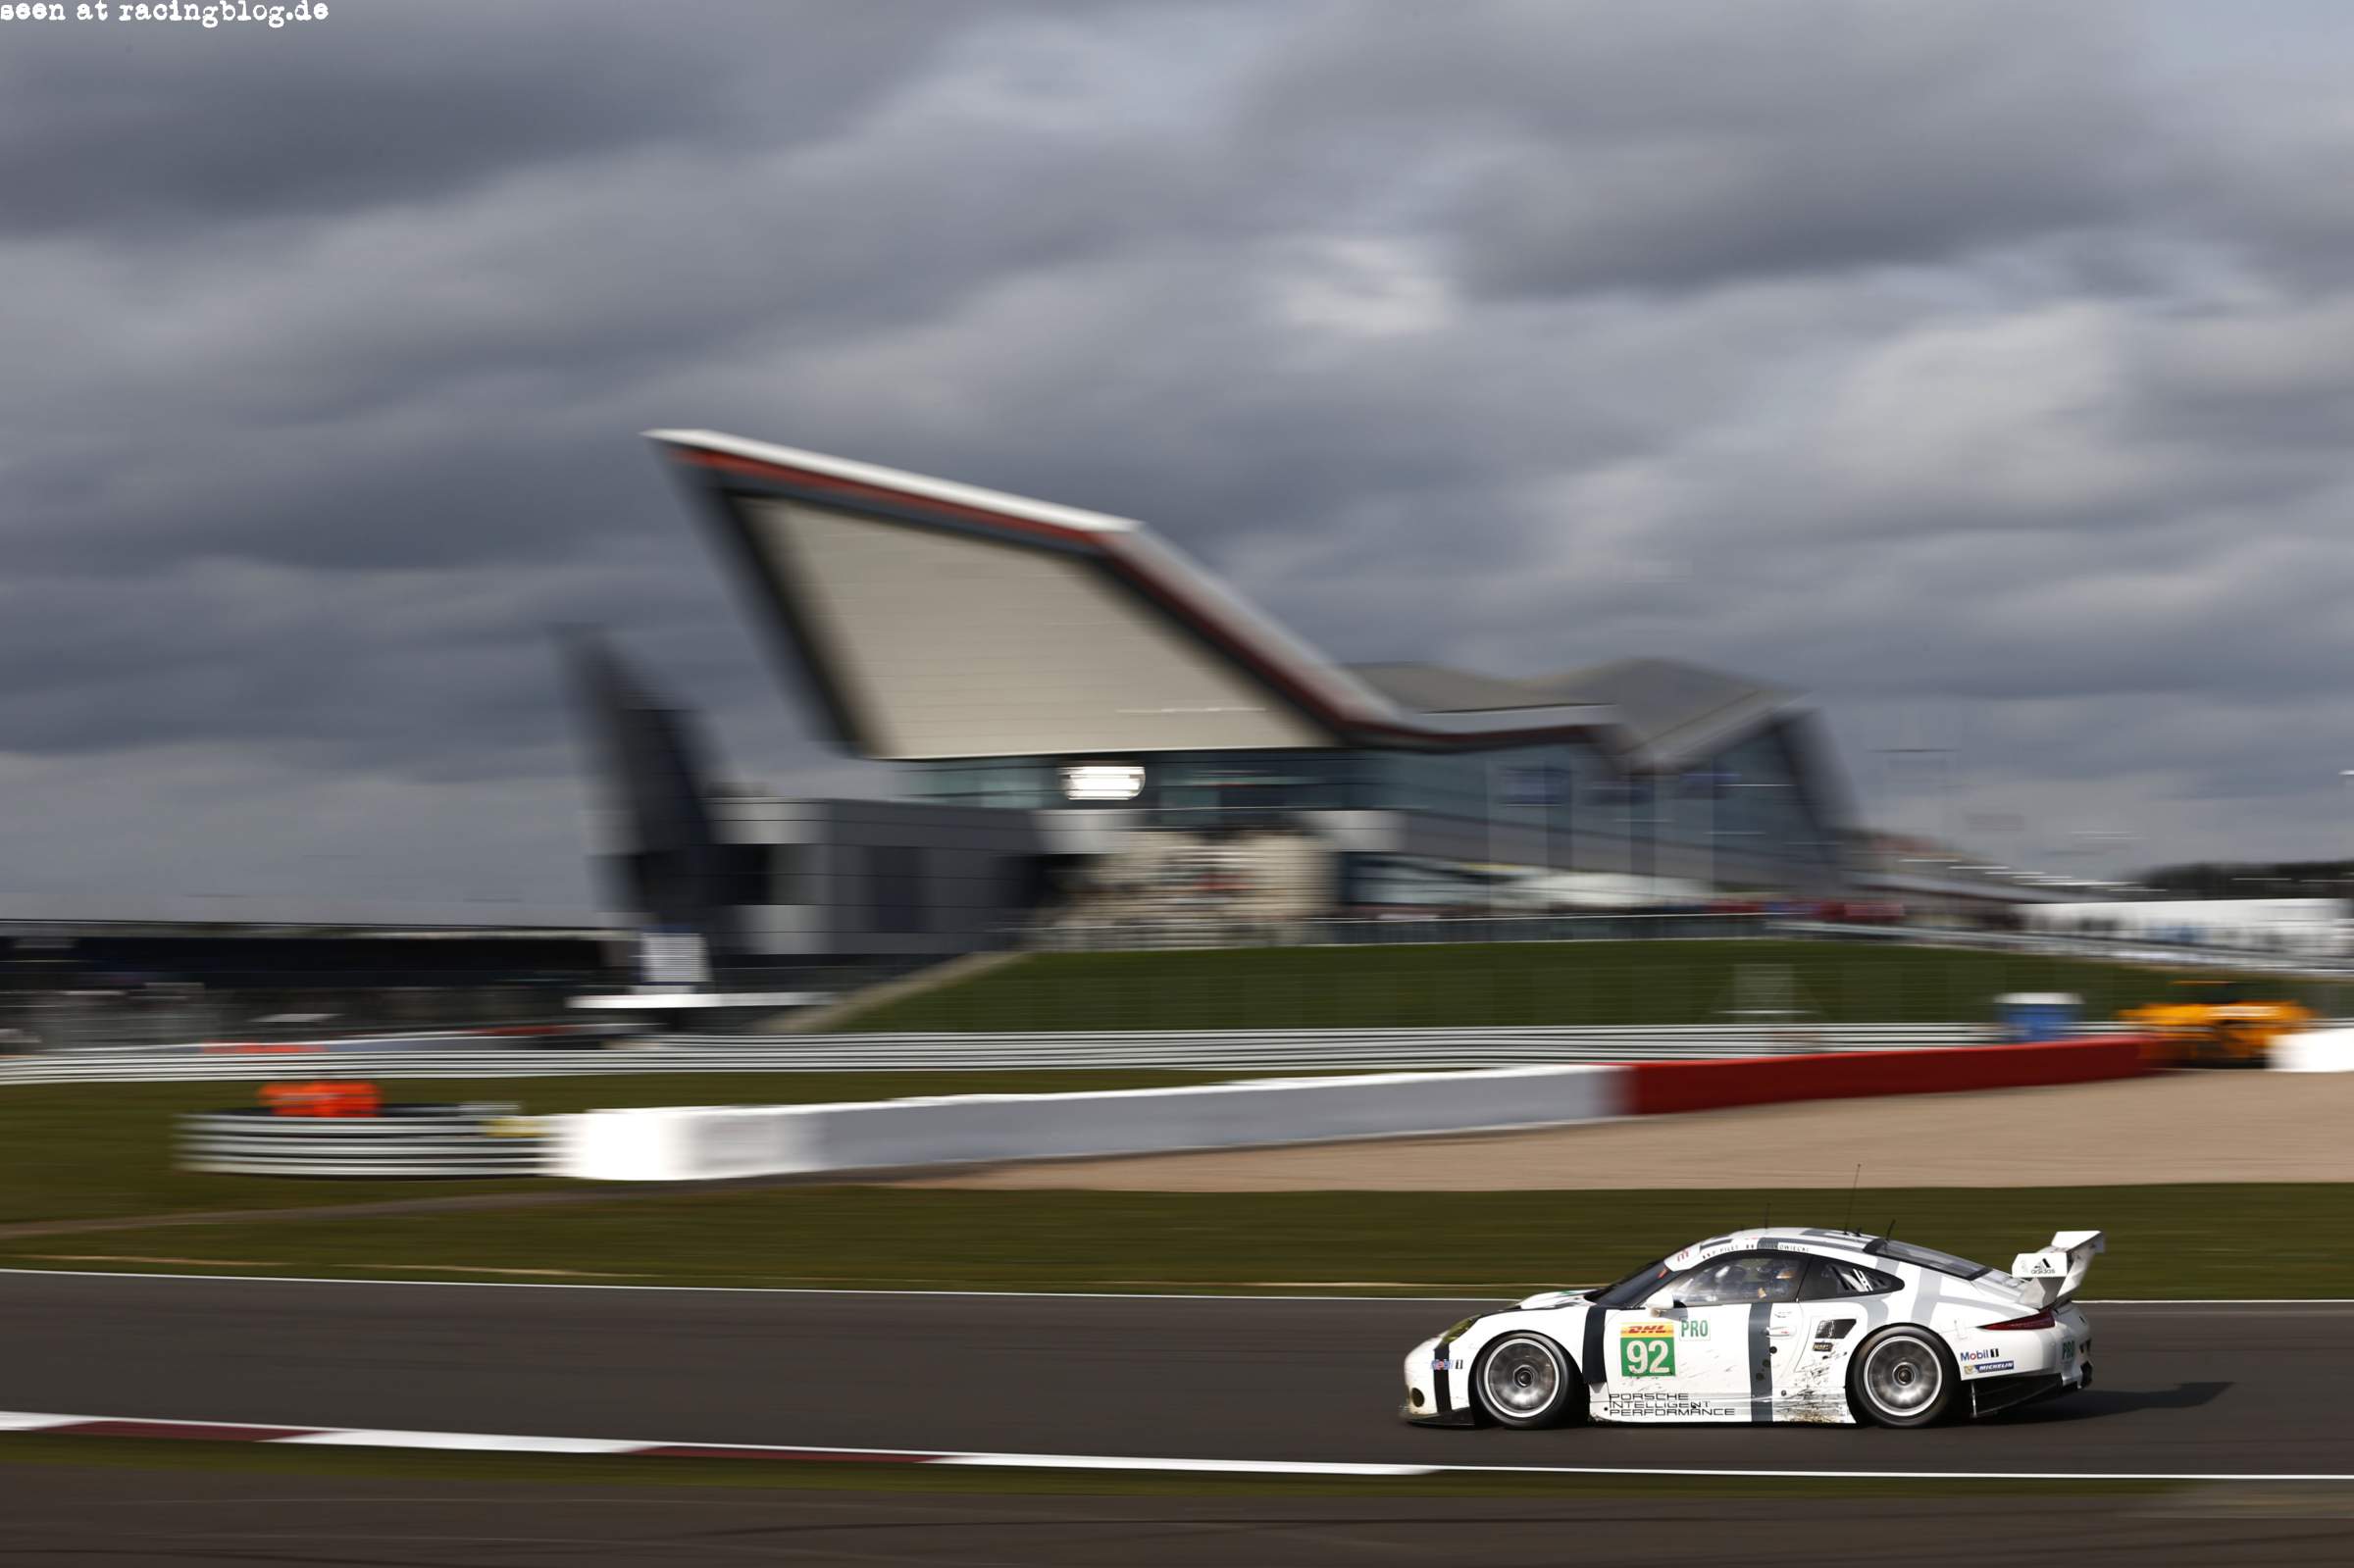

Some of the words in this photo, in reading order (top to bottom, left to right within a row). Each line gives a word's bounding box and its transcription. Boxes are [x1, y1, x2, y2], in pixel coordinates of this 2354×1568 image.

[1628, 1325, 1666, 1335] DHL
[1681, 1319, 1709, 1338] PRO
[1626, 1340, 1670, 1374] 92
[1960, 1348, 1989, 1361] Mobil
[1978, 1362, 2014, 1372] MICHELIN
[1609, 1392, 1689, 1401] PORSCHE
[1609, 1400, 1711, 1409] INTELLIGENT
[1609, 1408, 1736, 1417] PERFORMANCE
